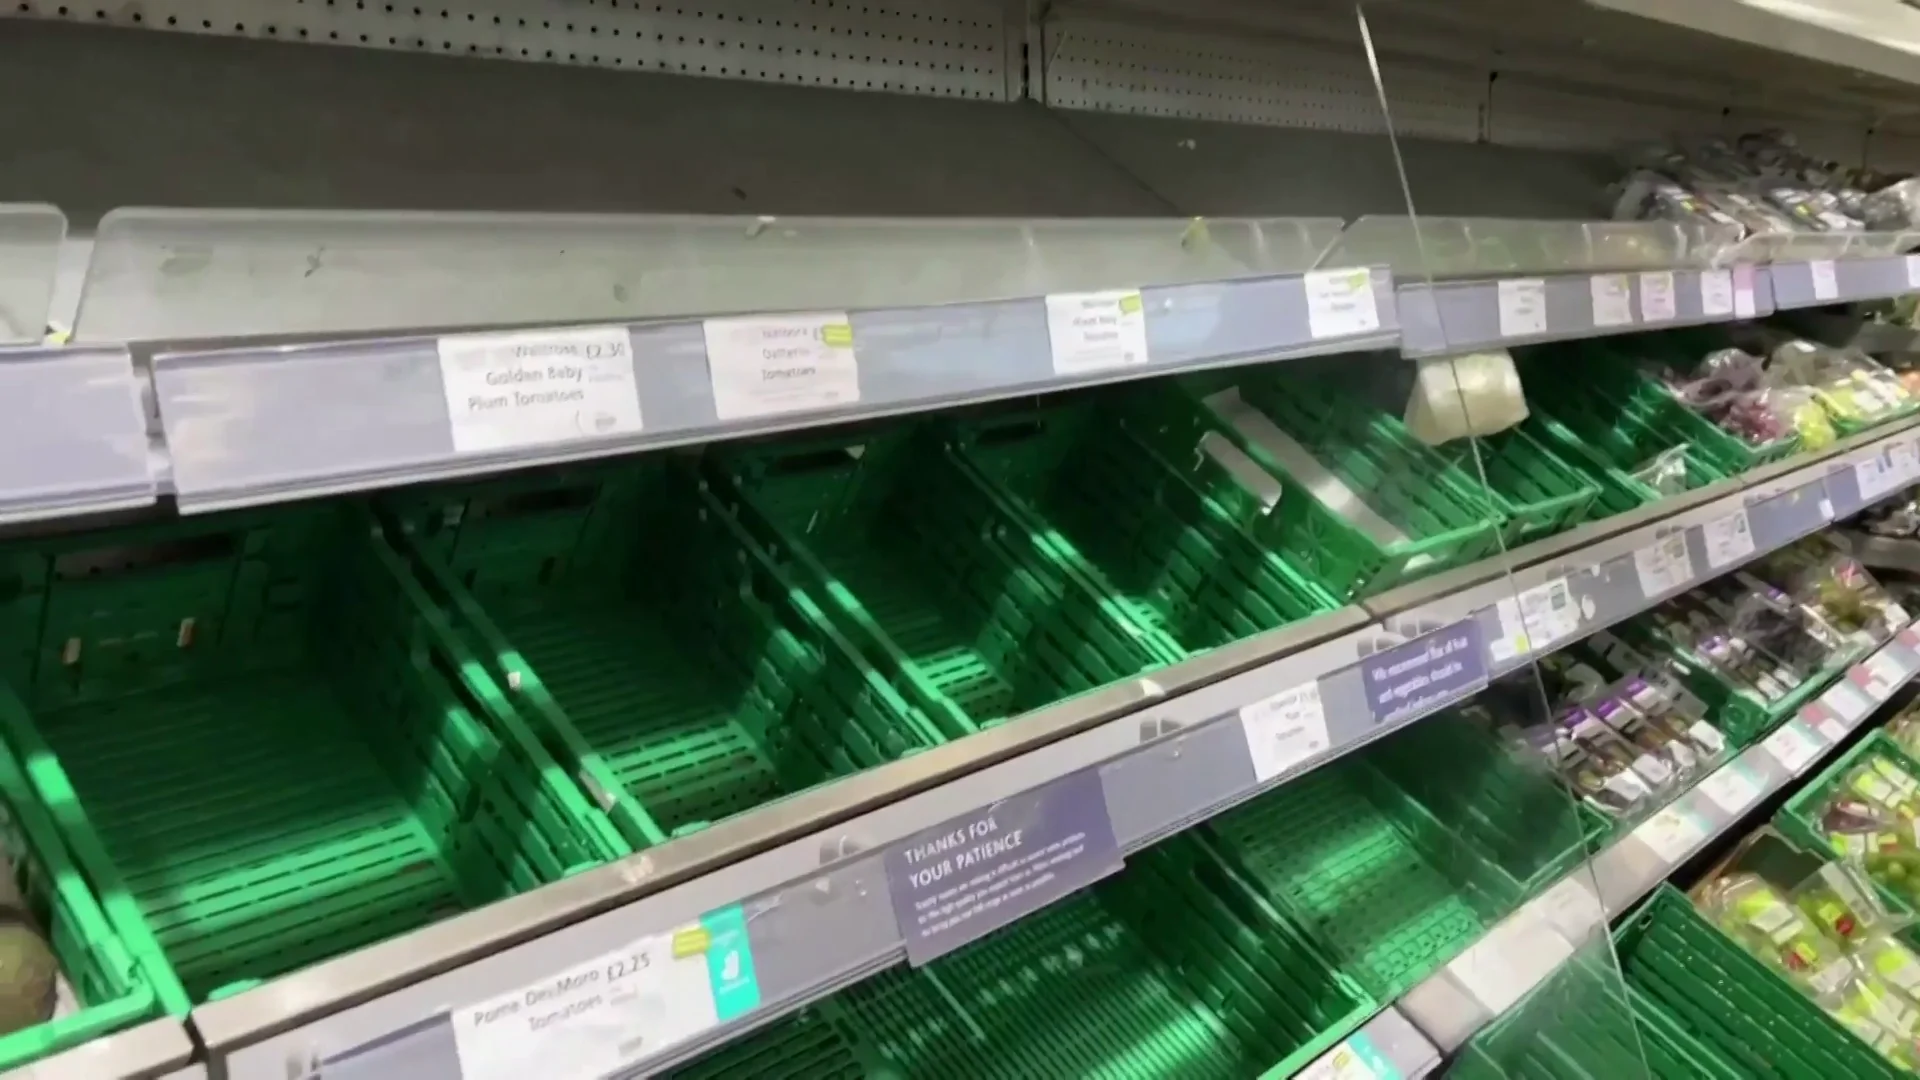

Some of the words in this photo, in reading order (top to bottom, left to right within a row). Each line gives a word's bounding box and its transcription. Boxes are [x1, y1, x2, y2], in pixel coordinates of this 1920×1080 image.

[486, 368, 543, 386] Golden
[547, 365, 582, 383] Baby
[468, 396, 508, 411] Plum
[514, 389, 584, 406] Tomatoes
[904, 828, 966, 865] THANKS
[968, 815, 998, 840] FOR
[909, 858, 953, 889] YOUR
[956, 829, 1023, 870] PATIENCE
[607, 952, 651, 983] £2.25
